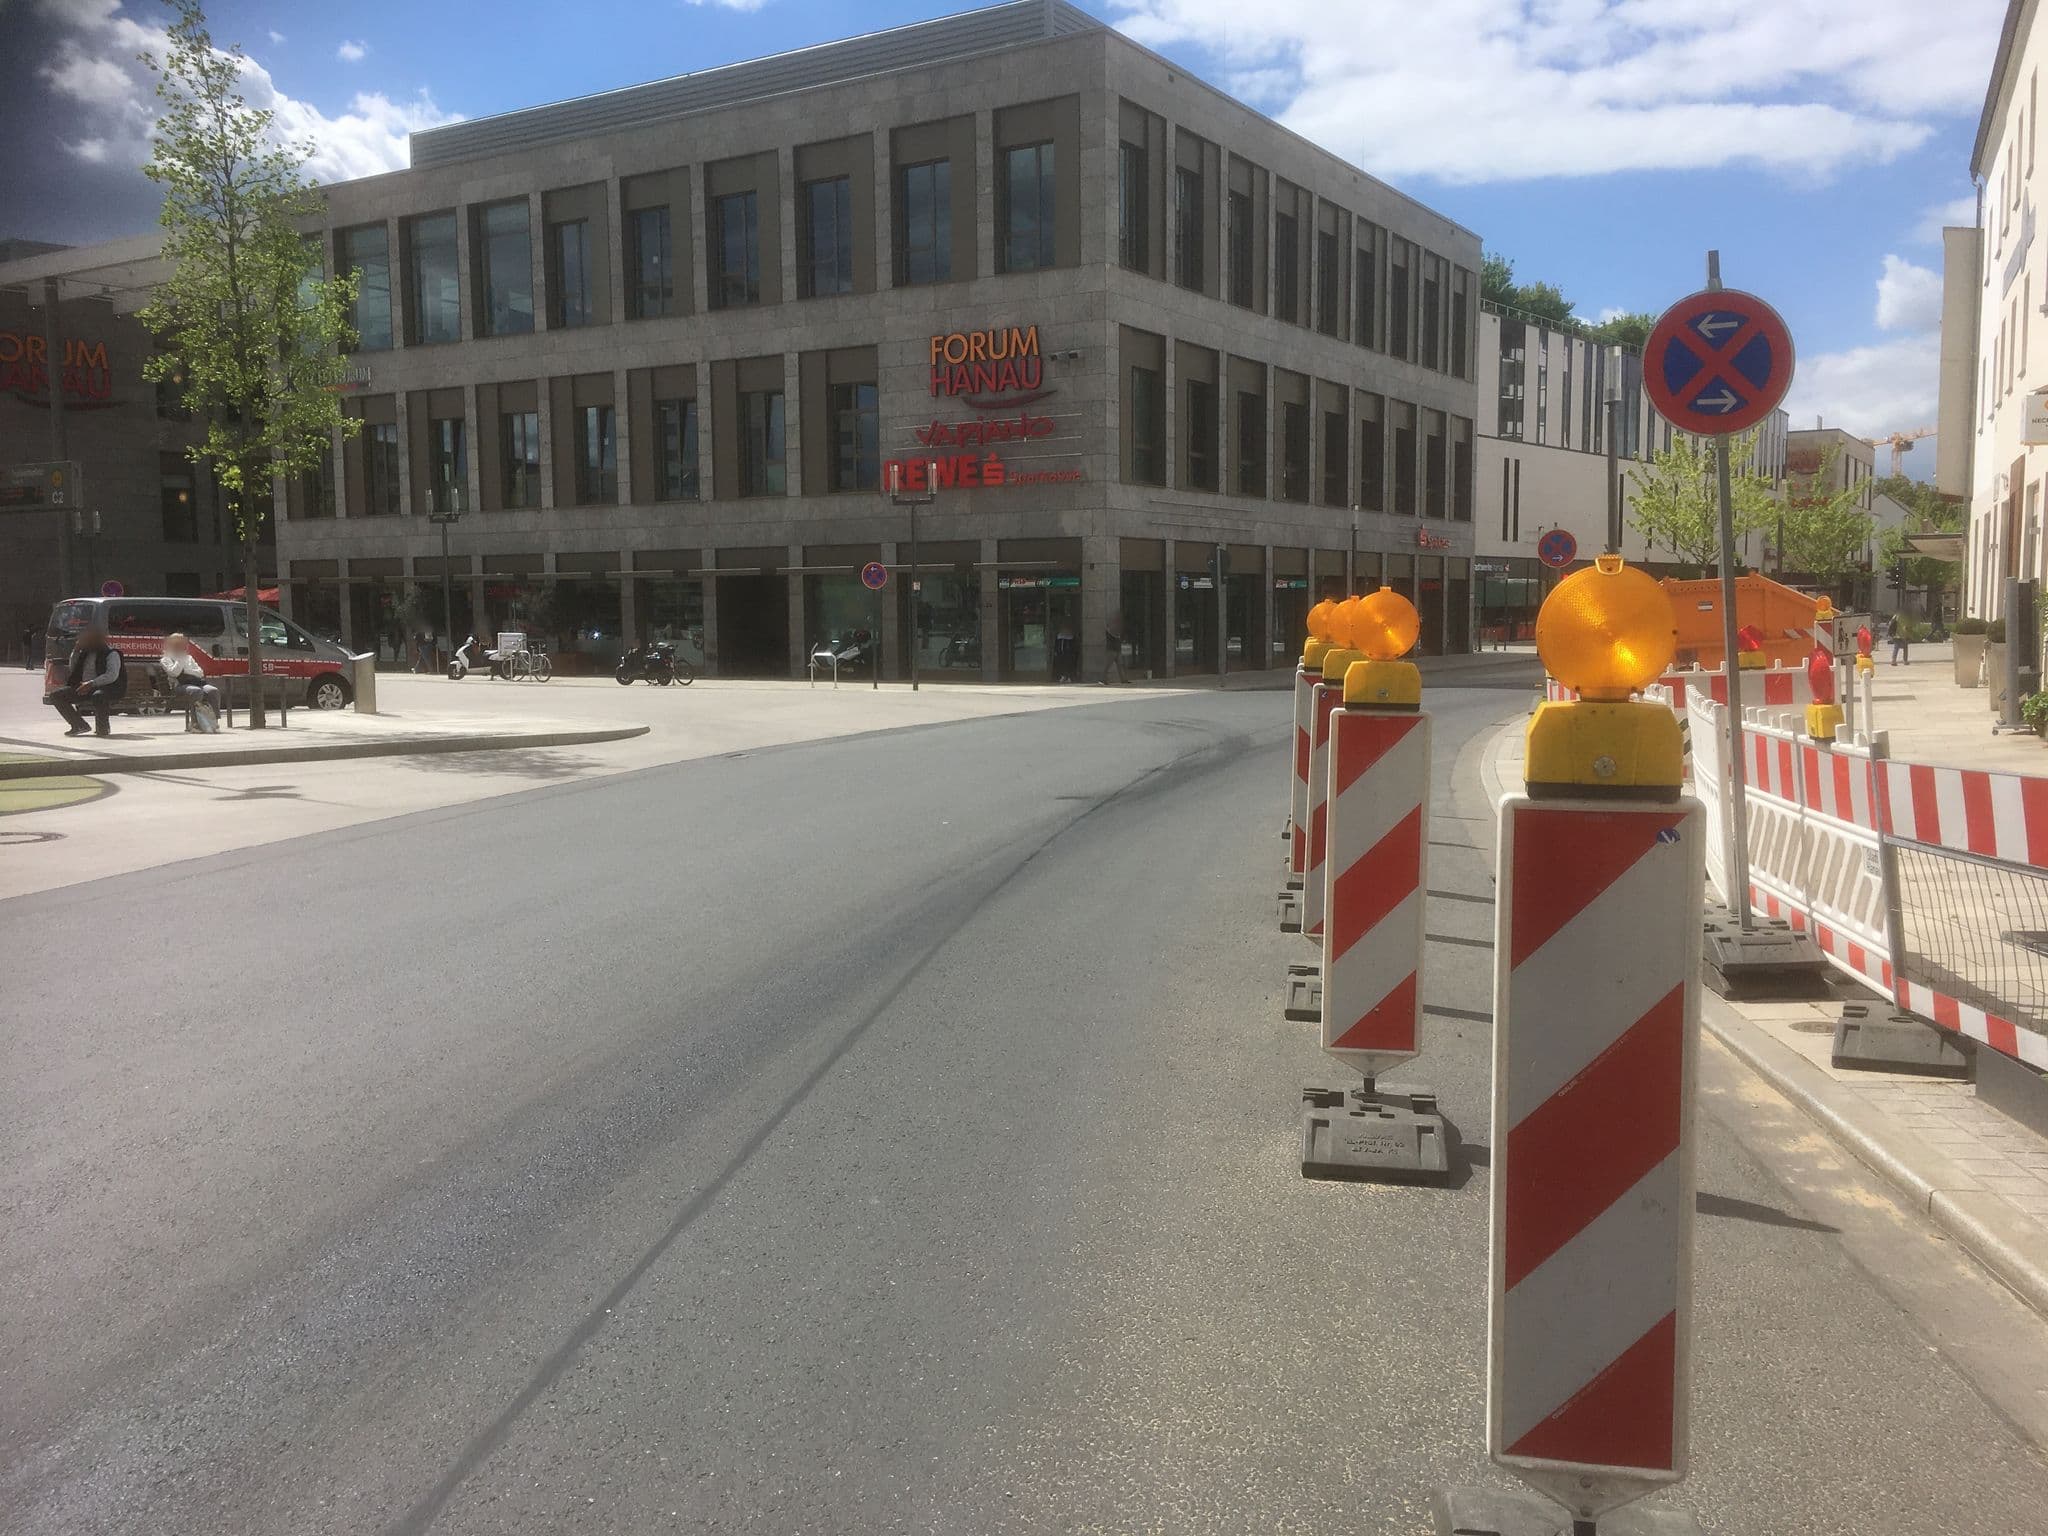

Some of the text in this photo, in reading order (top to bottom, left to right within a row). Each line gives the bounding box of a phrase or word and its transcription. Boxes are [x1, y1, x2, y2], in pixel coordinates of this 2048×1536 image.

[0, 332, 110, 369] ORM
[930, 324, 1040, 367] FORUM
[0, 361, 113, 399] ANAU
[929, 358, 1043, 397] HANAU
[883, 453, 979, 493] REWE
[108, 642, 164, 650] VERKEHRSAU
